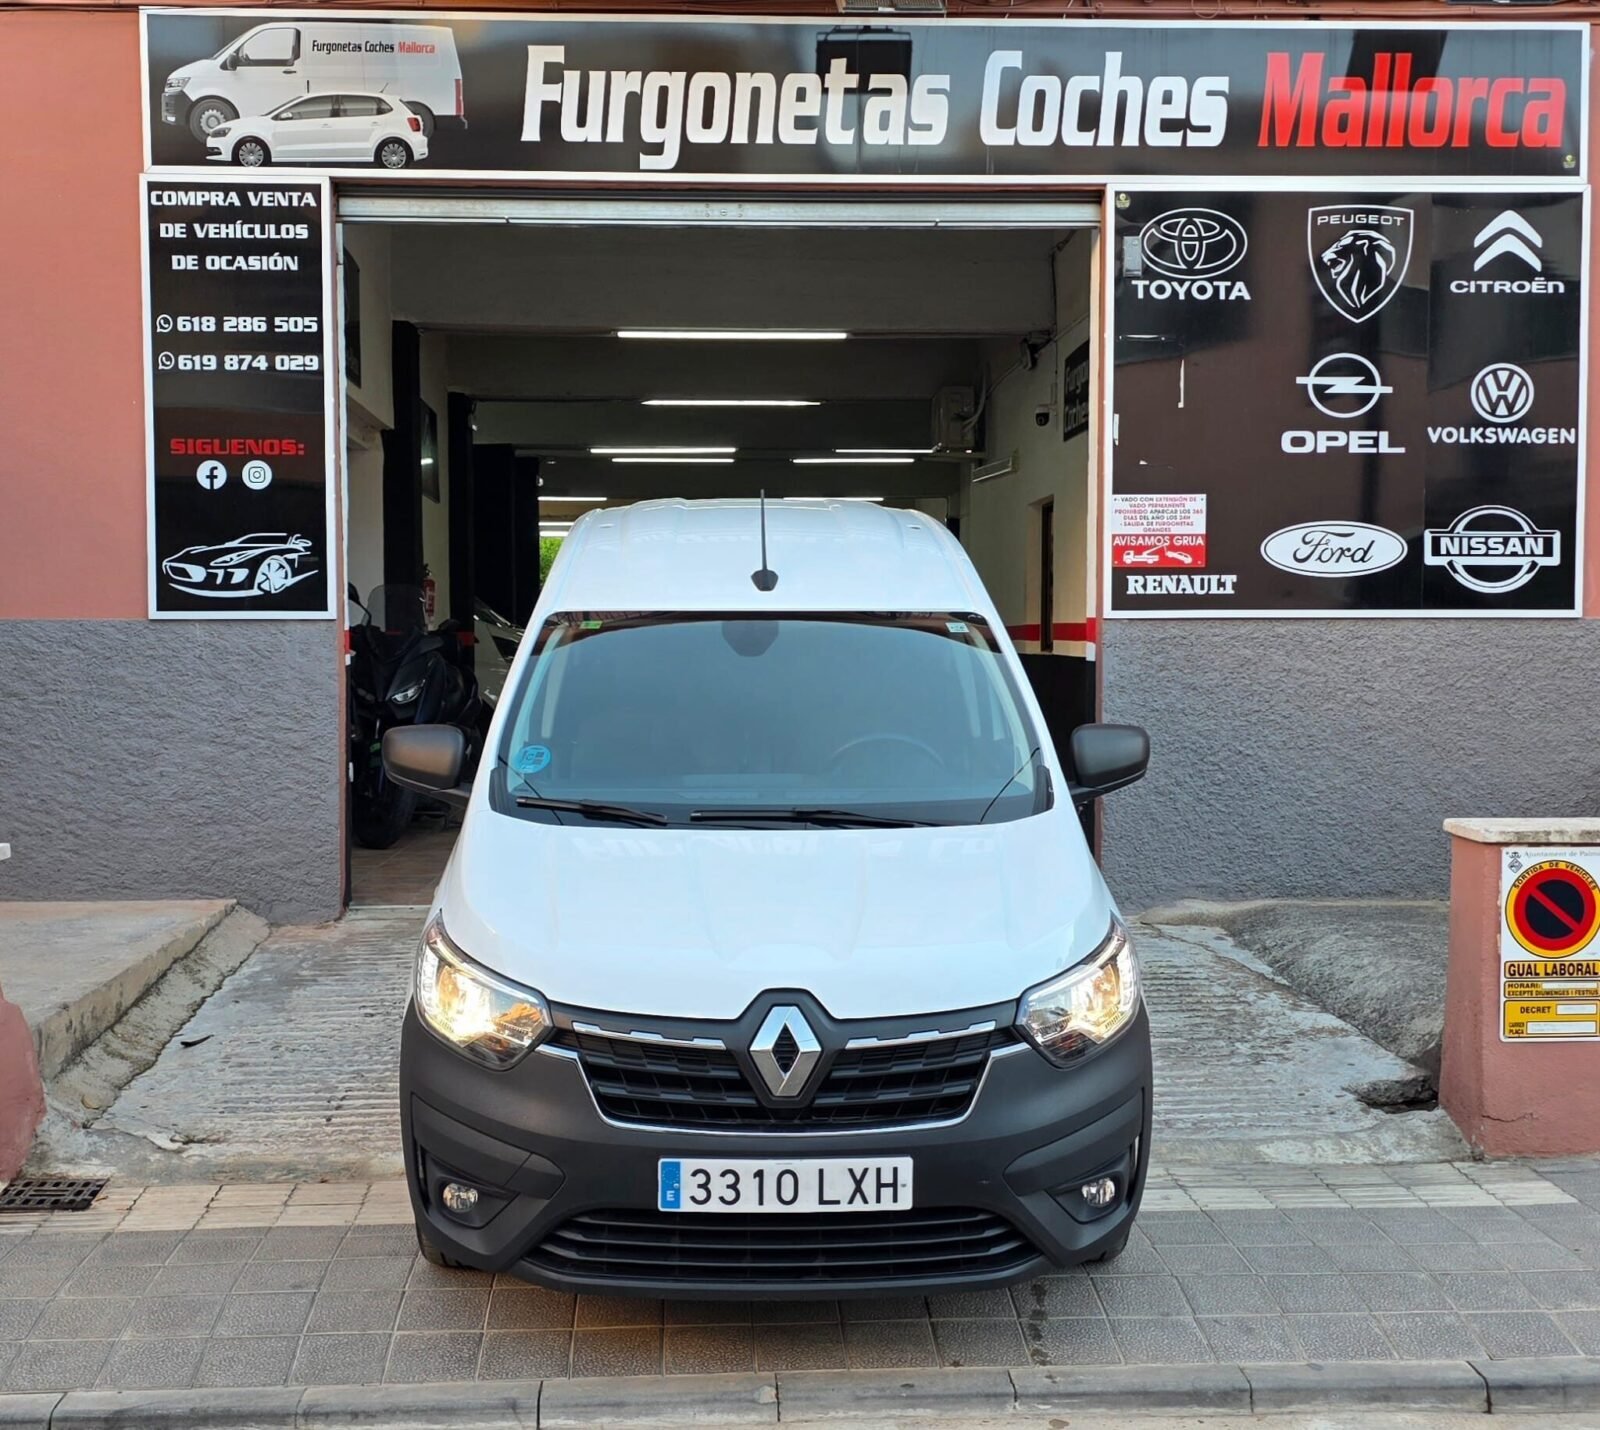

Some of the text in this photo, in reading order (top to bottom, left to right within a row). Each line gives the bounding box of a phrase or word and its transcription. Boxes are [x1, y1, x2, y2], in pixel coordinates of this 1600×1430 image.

[312, 40, 435, 55] Furgonetas Coches Mallorca
[520, 45, 1567, 171] Furgonetas Coches Mallorca
[150, 190, 316, 207] COMPRA VENTA
[160, 220, 308, 239] DE VEHÍCULOS
[1317, 215, 1405, 227] PEUGEOT
[171, 252, 298, 271] DE OCASIÓN
[1132, 280, 1251, 300] TOYOTA
[177, 316, 318, 332] 618 286 505
[178, 355, 319, 370] 619 874 029
[1281, 430, 1405, 453] OPEL
[1427, 427, 1575, 444] VOLKSWAGEN
[170, 438, 305, 455] SIGUENOS:
[1113, 535, 1204, 546] AVISAMOS GRUA
[1293, 531, 1373, 564] Ford
[1440, 536, 1545, 555] NISSAN
[1126, 574, 1237, 595] RENAULT
[1514, 864, 1544, 889] SORTIDA
[1565, 863, 1597, 891] VEHICLES
[1508, 962, 1599, 977] GUAL LABORAL
[1520, 1006, 1551, 1014] DECRET
[666, 1166, 899, 1206] E 3310 LXH
